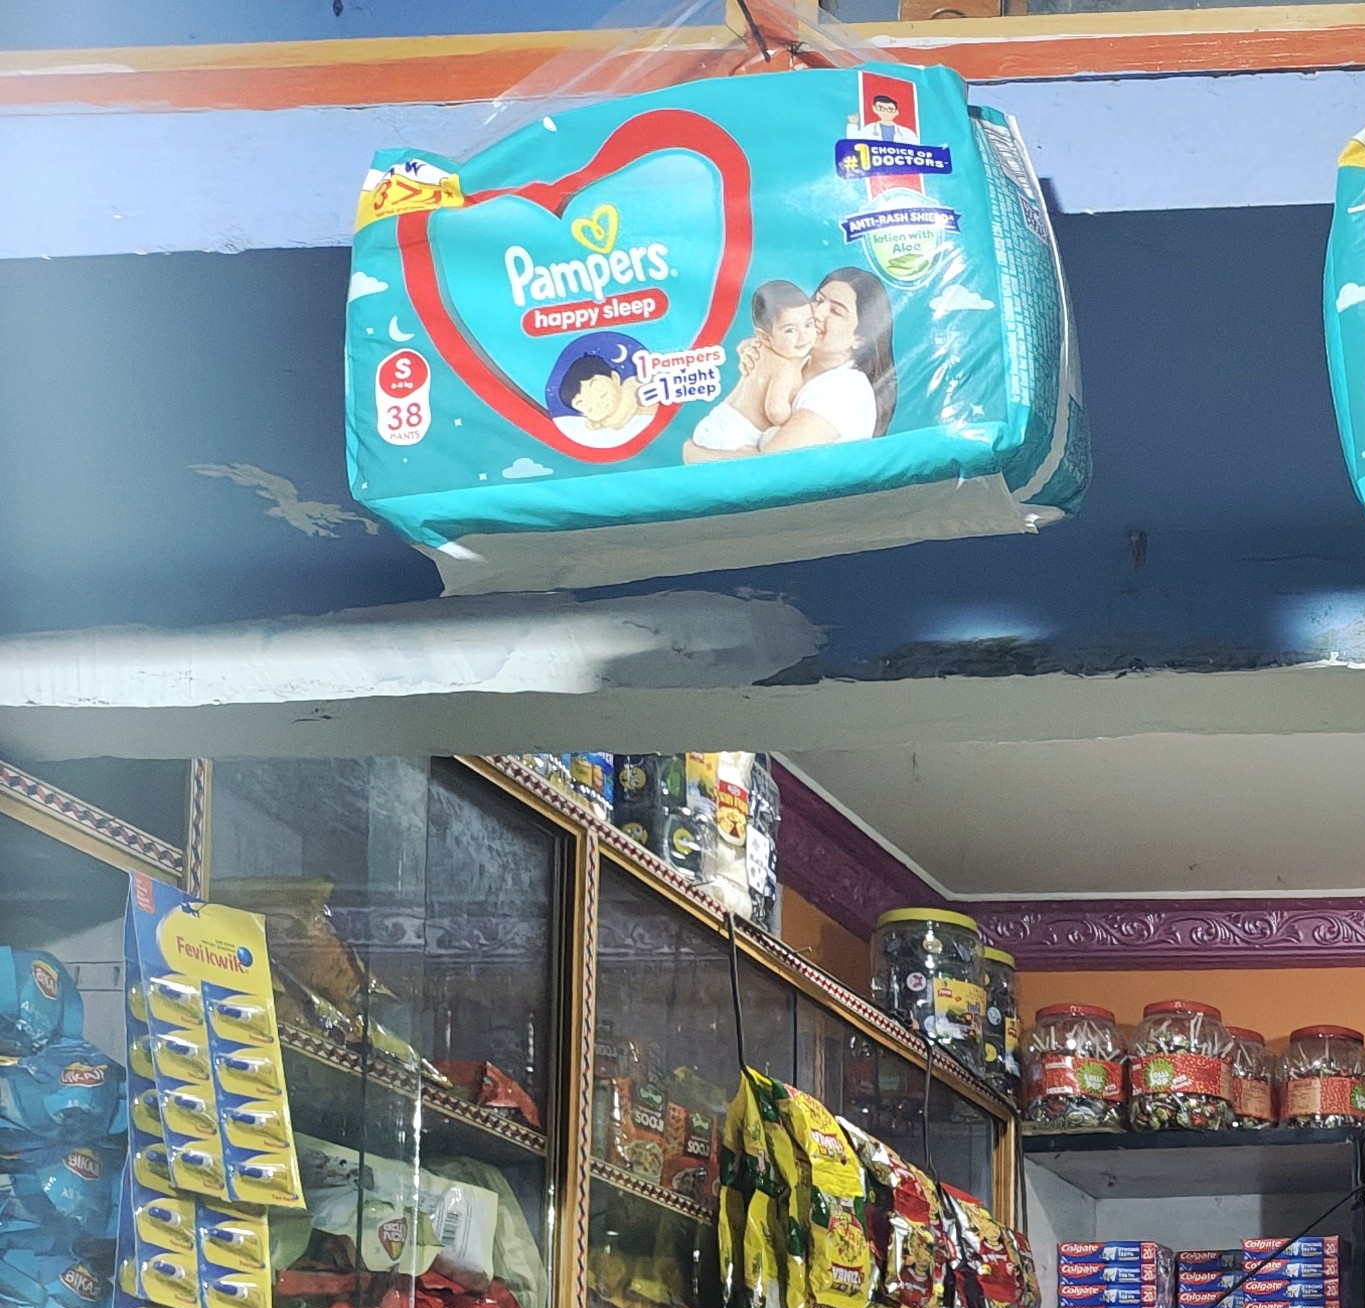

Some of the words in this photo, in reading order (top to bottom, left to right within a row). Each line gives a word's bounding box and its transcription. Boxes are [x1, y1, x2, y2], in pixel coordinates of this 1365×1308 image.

[871, 146, 914, 156] CHOICE
[871, 155, 945, 168] DOCTORS
[850, 213, 909, 232] ANTI-RASH
[892, 243, 921, 254] Aloe
[504, 244, 668, 306] Pampers
[535, 306, 598, 329] happy
[603, 298, 655, 318] sleep
[652, 350, 720, 370] Pampers
[395, 358, 411, 379] S
[673, 368, 715, 387] night
[675, 382, 716, 397] sleep
[387, 402, 422, 431] 38
[1061, 1243, 1098, 1255] Colgate
[1244, 1239, 1282, 1250] Colgate
[1061, 1264, 1099, 1276] Colgate
[1061, 1286, 1100, 1297] Colgate
